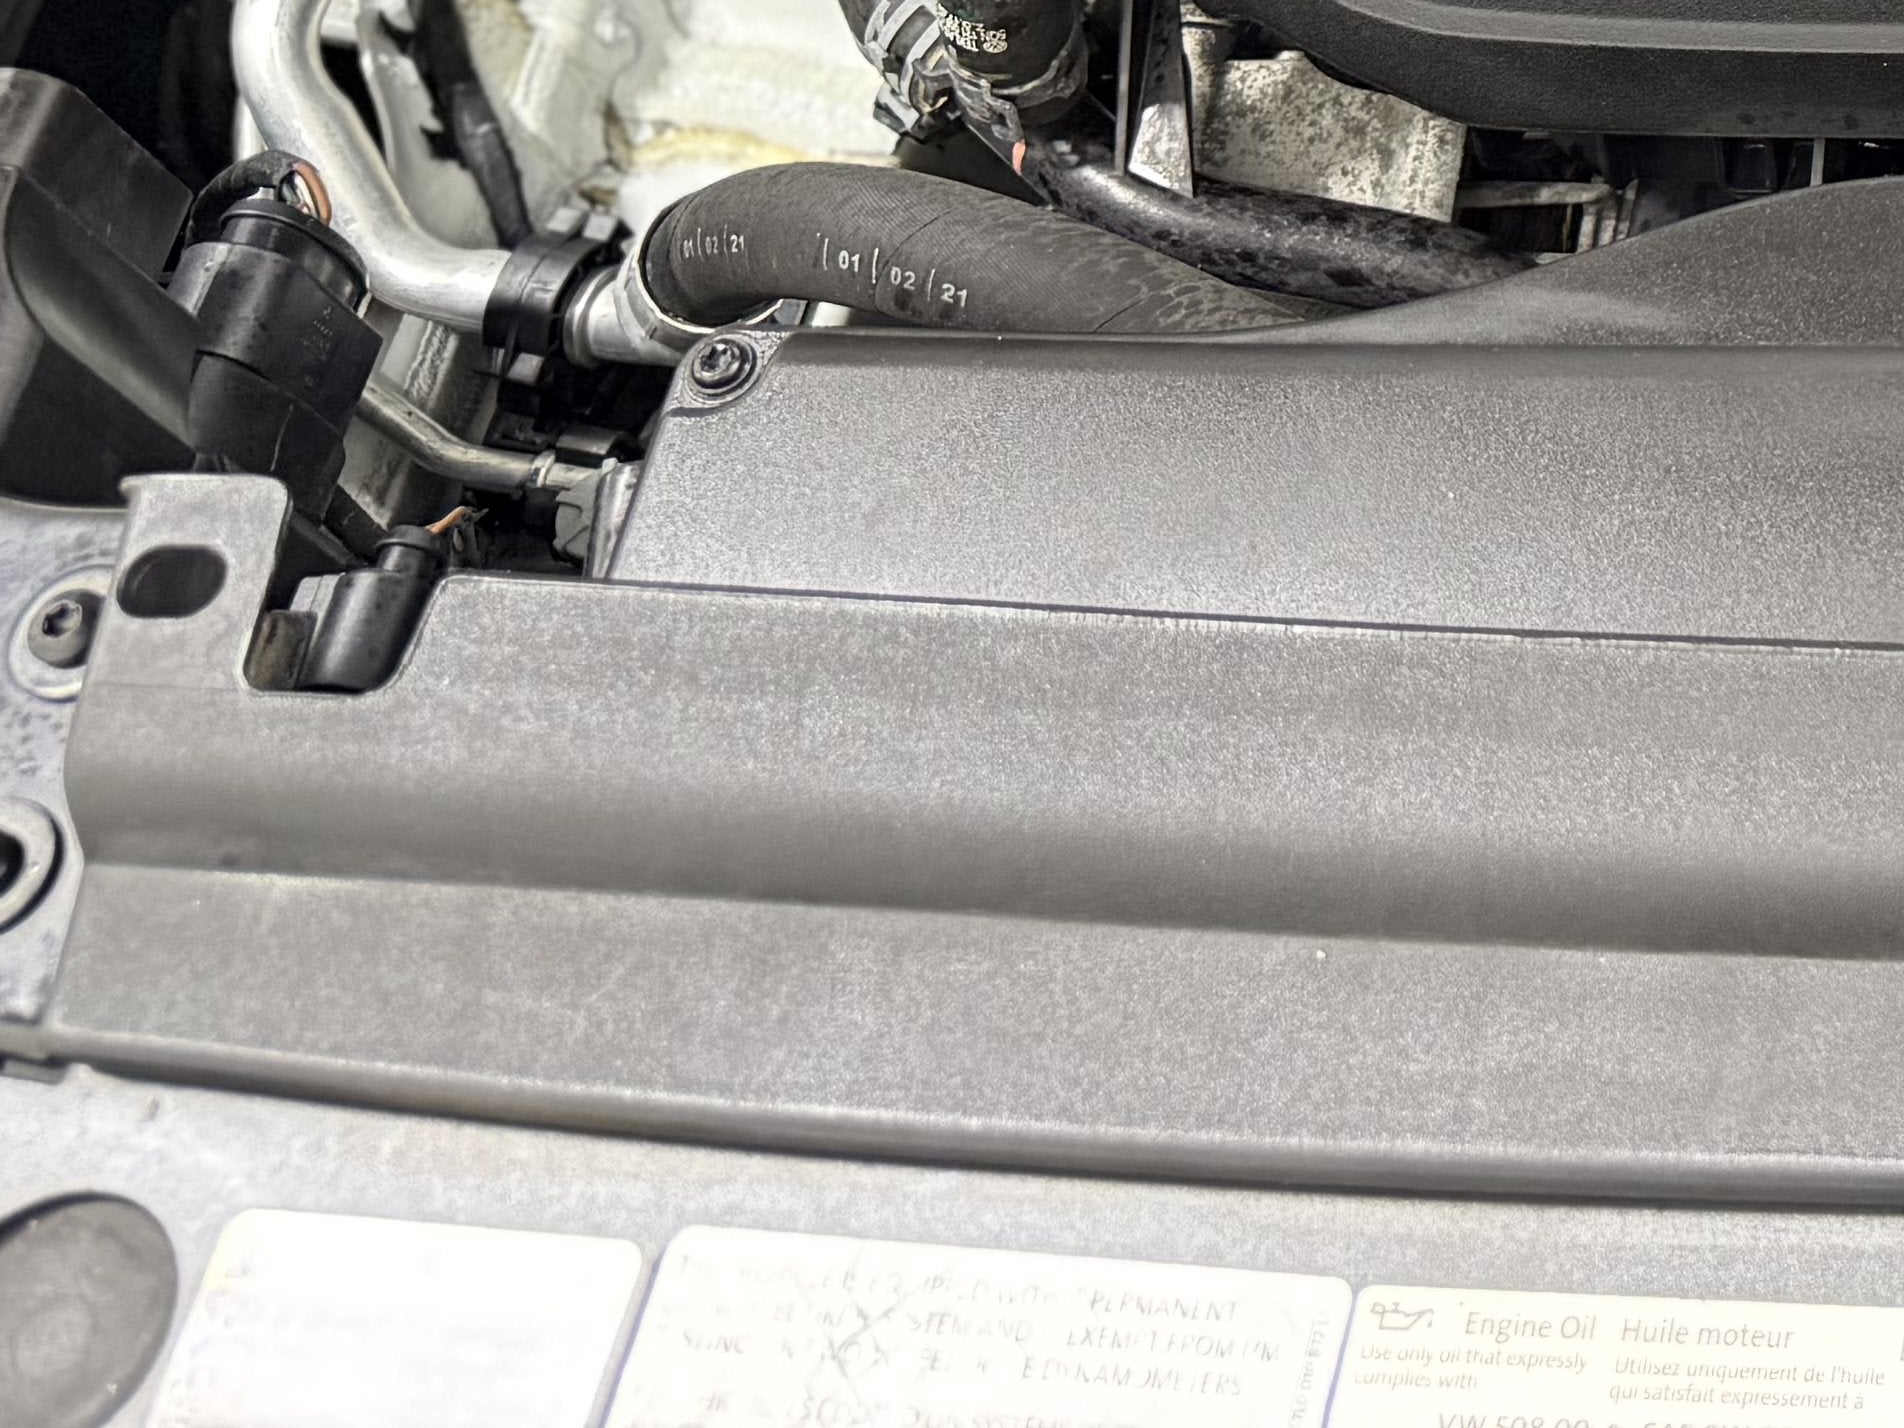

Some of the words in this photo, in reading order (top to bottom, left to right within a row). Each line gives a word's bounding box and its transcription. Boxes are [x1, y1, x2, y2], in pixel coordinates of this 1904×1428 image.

[837, 249, 860, 274] 01
[889, 264, 916, 291] 02
[940, 282, 969, 309] 21
[1465, 1311, 1552, 1344] Engine
[1560, 1315, 1597, 1340] Oil
[1621, 1318, 1689, 1345] Huile
[1697, 1324, 1795, 1349] moteur
[1397, 1346, 1433, 1367] only
[1465, 1348, 1501, 1366] that
[1506, 1352, 1588, 1375] expressly
[1614, 1356, 1681, 1377] Utilisez
[1686, 1361, 1798, 1384] uniquement
[1804, 1364, 1826, 1384] de
[1831, 1366, 1886, 1386] l'huile
[1354, 1370, 1432, 1391] complies
[1438, 1371, 1478, 1390] with
[1608, 1384, 1639, 1405] qui
[1643, 1383, 1715, 1404] satisfait
